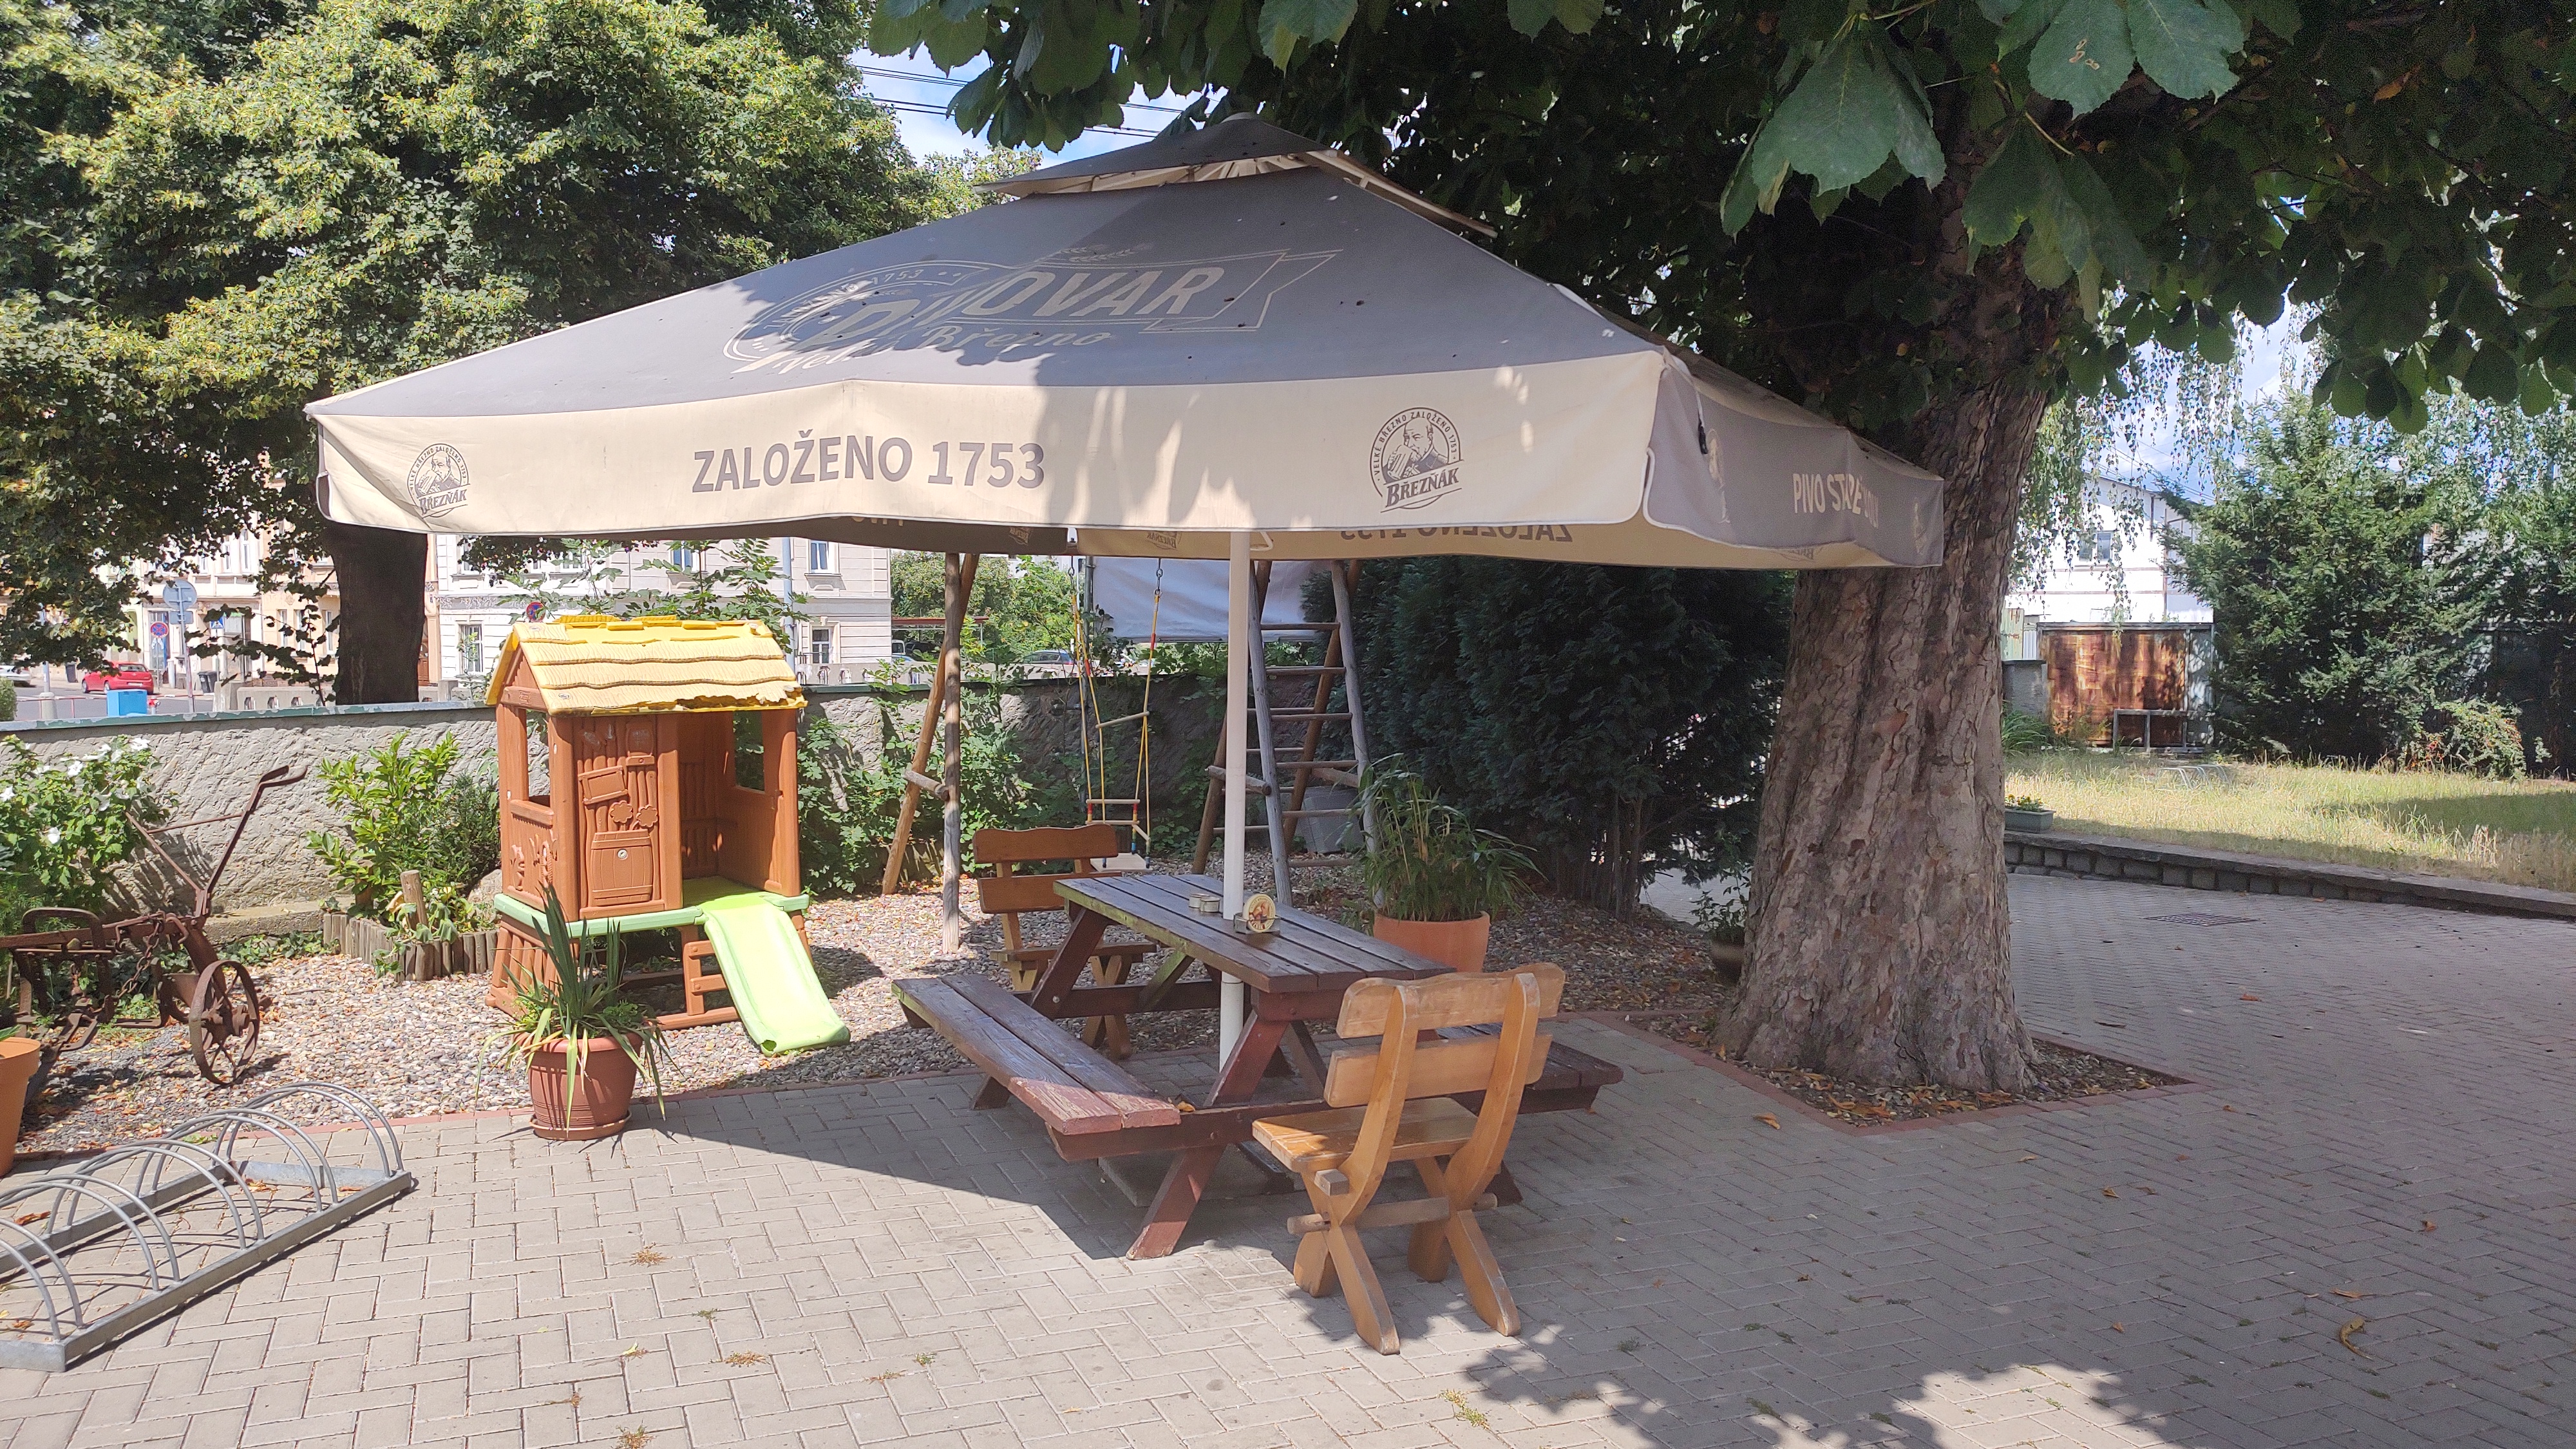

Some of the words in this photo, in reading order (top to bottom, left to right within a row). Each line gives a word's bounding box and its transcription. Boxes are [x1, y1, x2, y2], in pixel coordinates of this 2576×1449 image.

[1410, 410, 1451, 433] ZALOŽENO
[1448, 434, 1457, 453] 1753
[692, 428, 913, 493] ZALOŽENO
[927, 440, 1045, 489] 1753
[419, 488, 468, 516] BŘEZŇÁK
[1385, 466, 1460, 508] BŘEZŇÁK
[1792, 473, 1826, 514] PIVO
